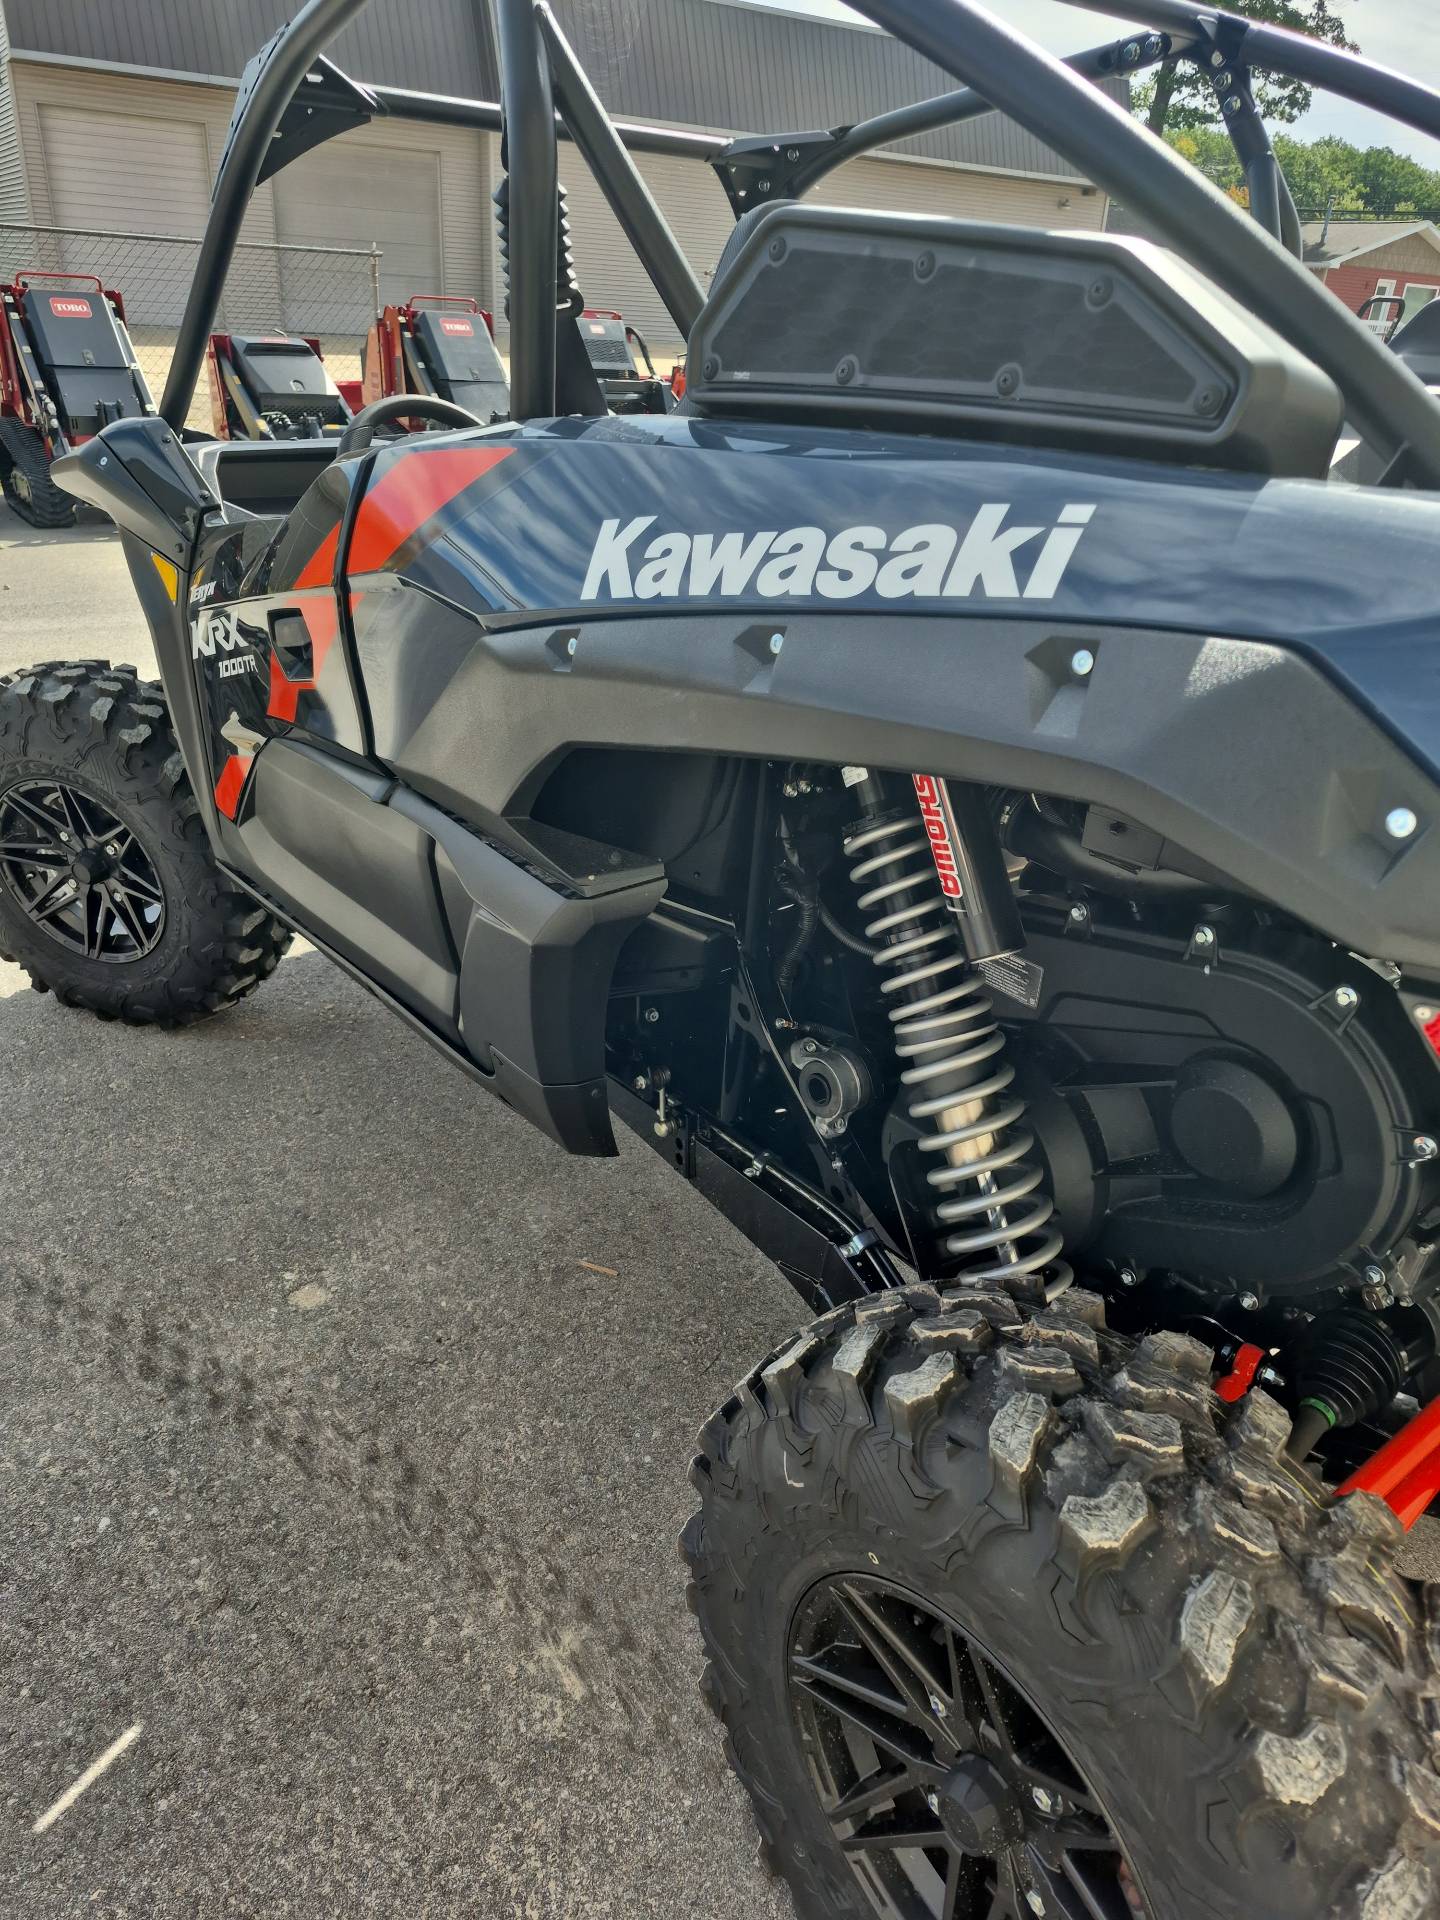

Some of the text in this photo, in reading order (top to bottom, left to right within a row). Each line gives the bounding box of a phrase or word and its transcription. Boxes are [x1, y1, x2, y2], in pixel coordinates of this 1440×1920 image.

[53, 303, 88, 312] TORO
[580, 503, 1097, 600] Kawasaki
[190, 608, 250, 660] KRX
[911, 773, 963, 899] SHOWA
